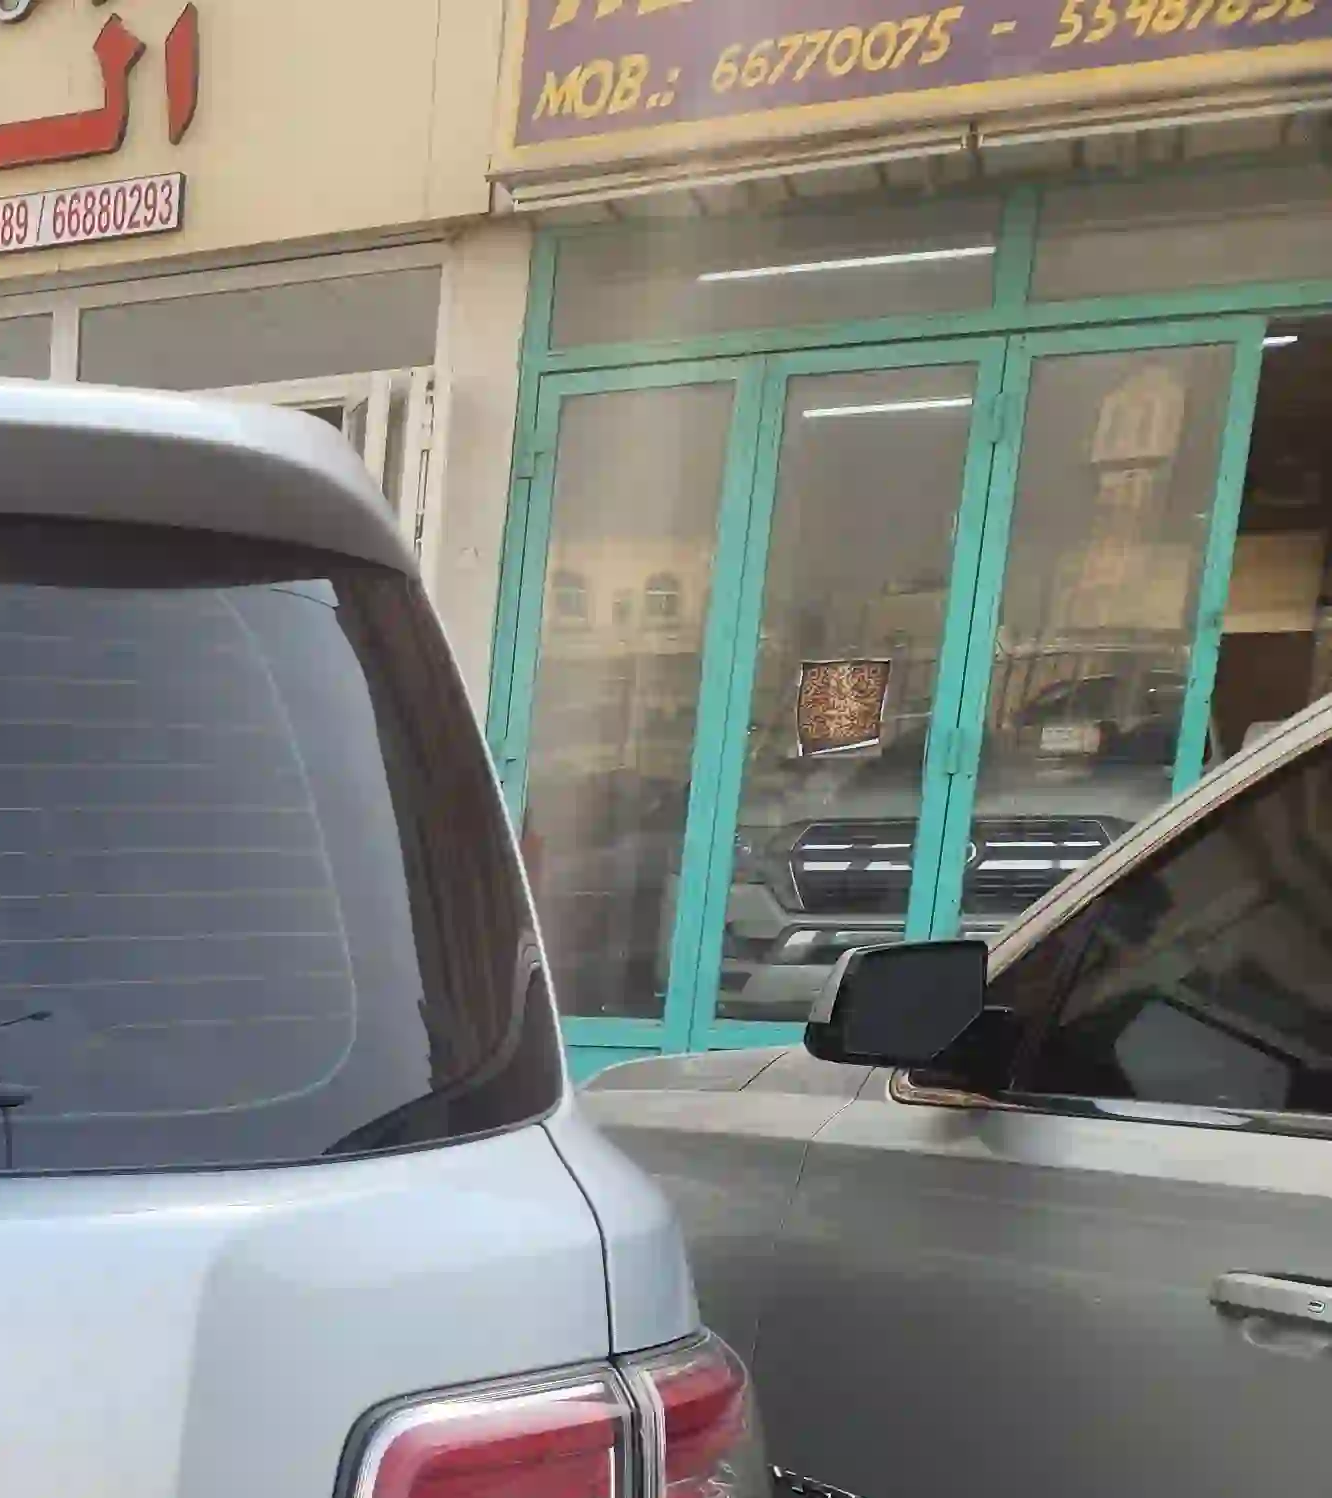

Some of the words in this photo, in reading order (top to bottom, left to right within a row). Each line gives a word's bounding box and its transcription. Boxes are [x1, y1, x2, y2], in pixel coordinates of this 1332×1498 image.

[532, 53, 681, 121] MOB.:
[710, 5, 965, 95] 66770075
[52, 178, 174, 239] 66880293
